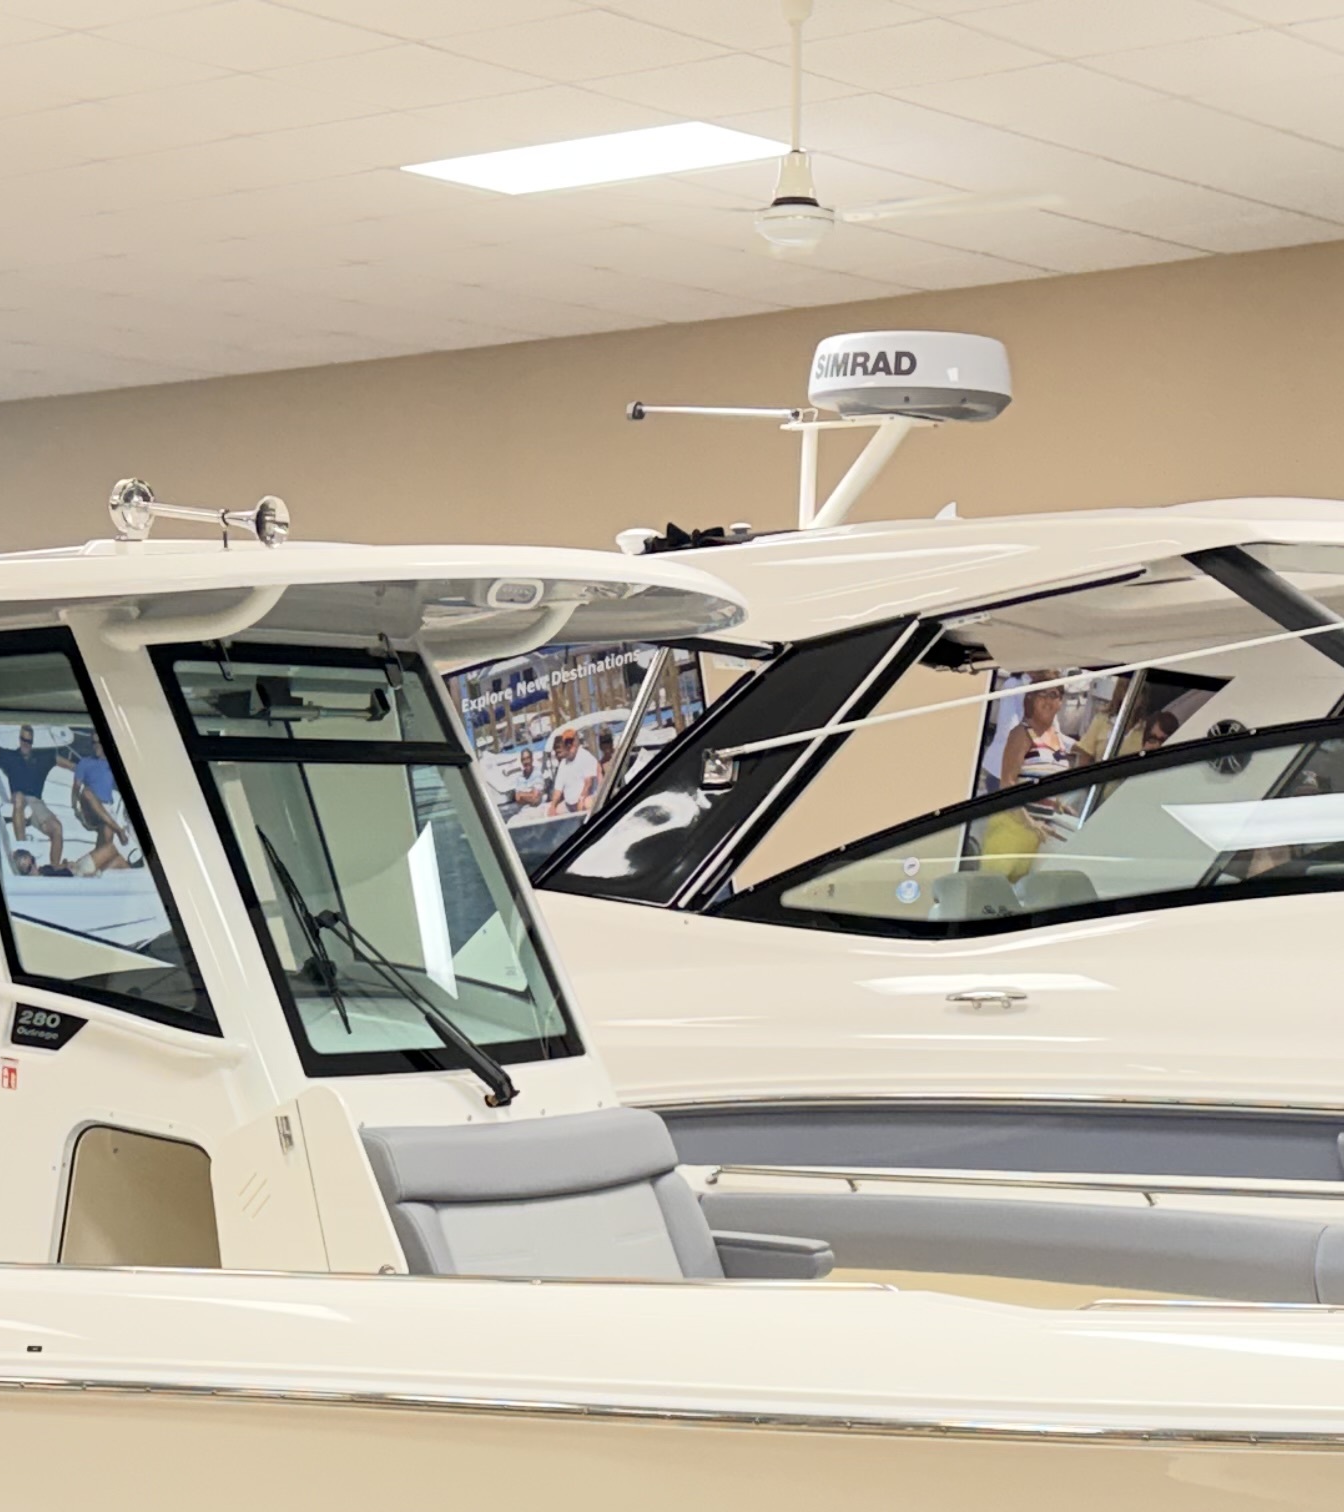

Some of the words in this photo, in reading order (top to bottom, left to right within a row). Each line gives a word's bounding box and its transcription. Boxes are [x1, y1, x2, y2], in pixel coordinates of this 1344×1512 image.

[815, 350, 918, 379] SIMRAD
[461, 686, 513, 712] Explore
[516, 676, 550, 697] New
[551, 648, 641, 687] Destinations
[18, 1010, 61, 1028] 280
